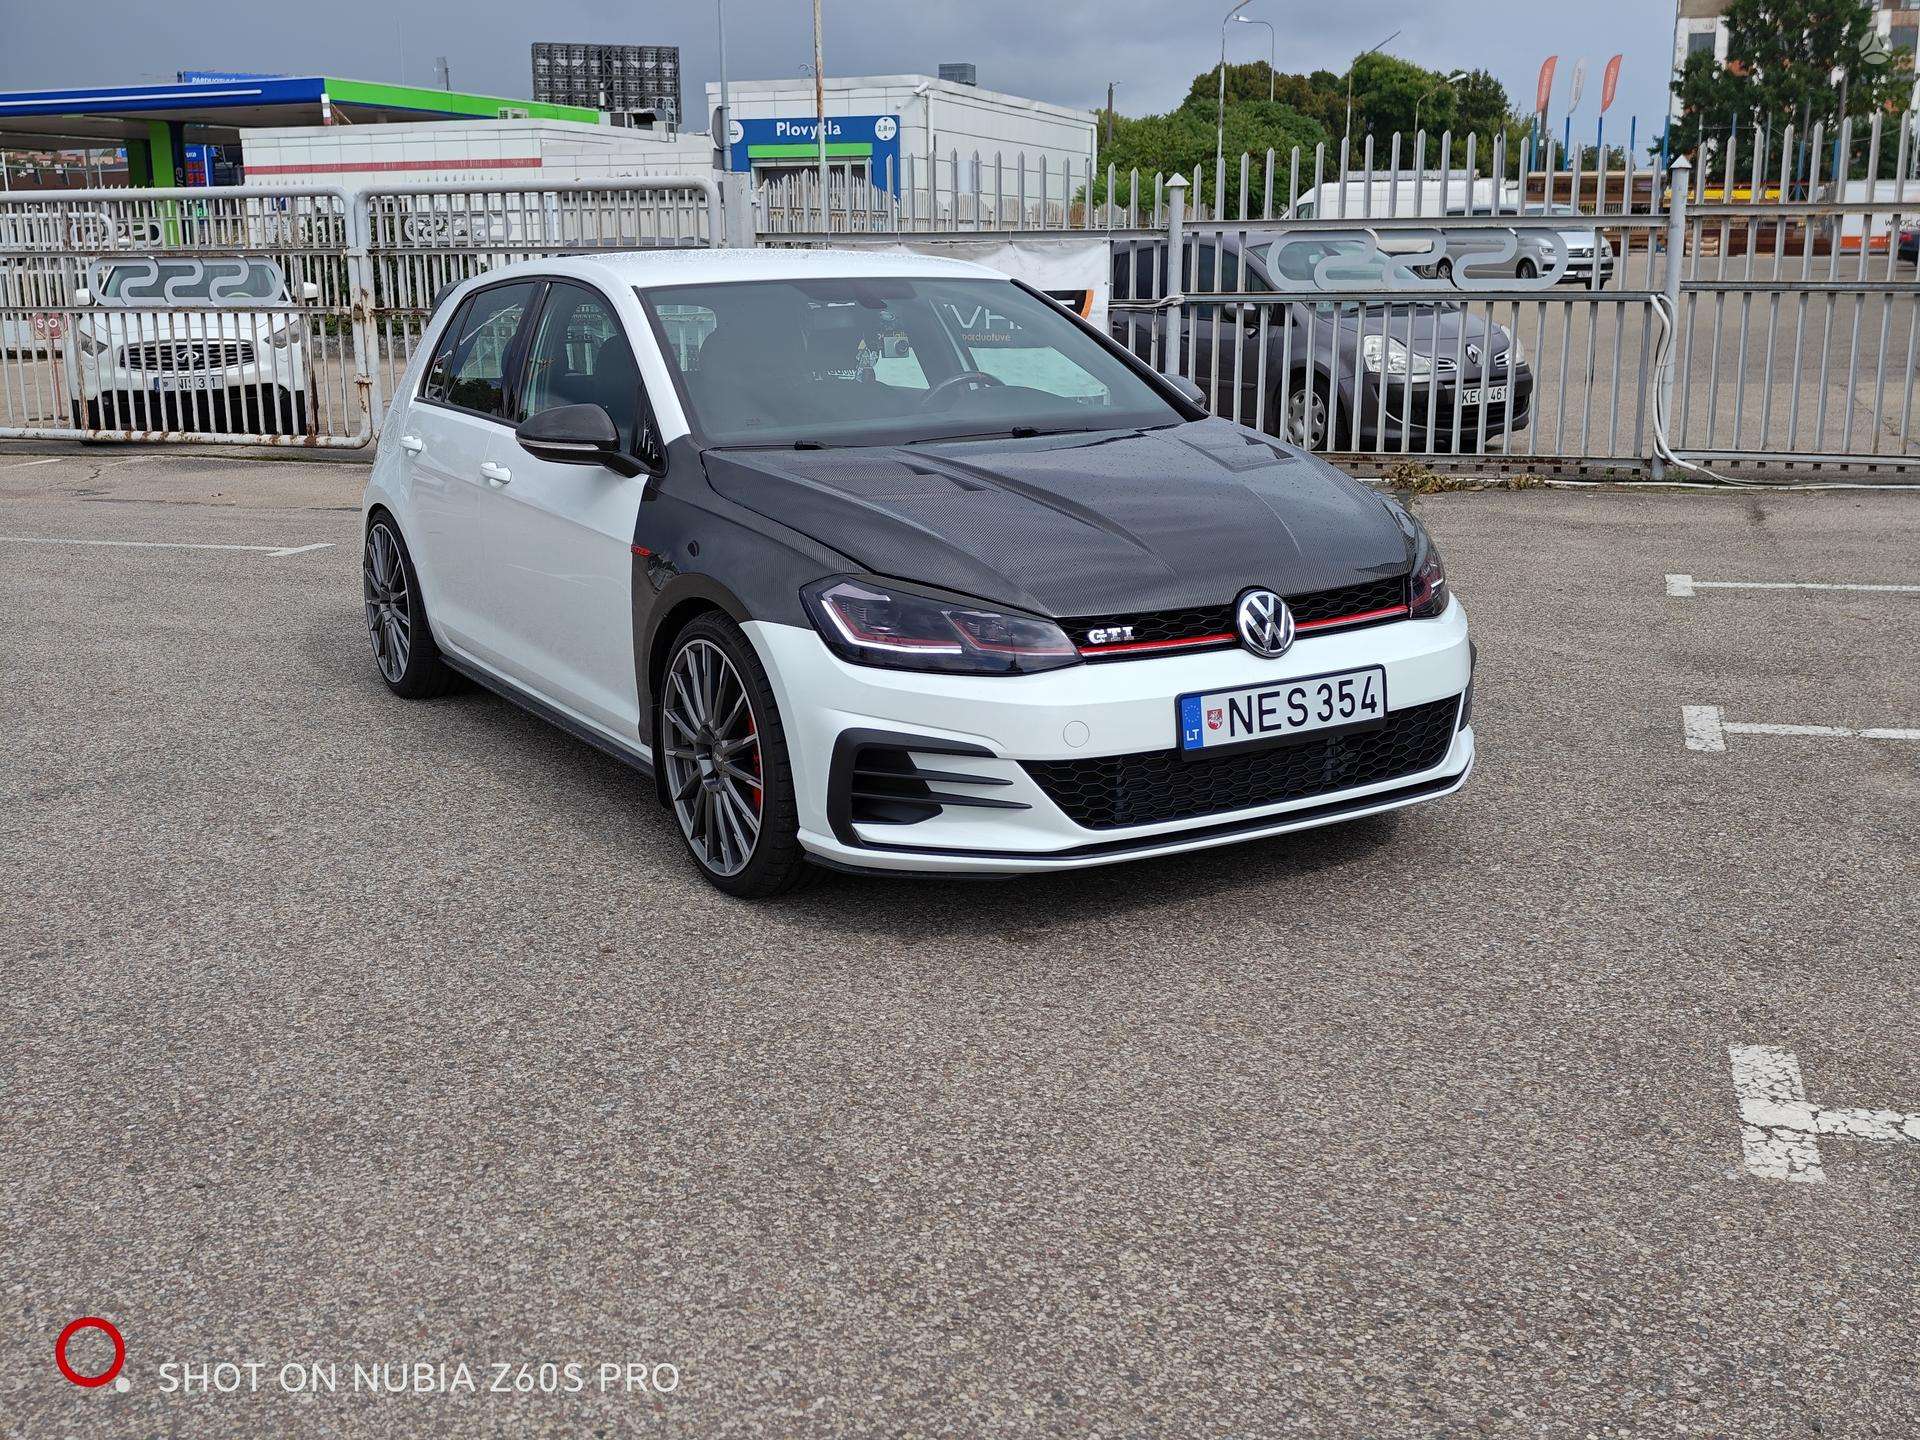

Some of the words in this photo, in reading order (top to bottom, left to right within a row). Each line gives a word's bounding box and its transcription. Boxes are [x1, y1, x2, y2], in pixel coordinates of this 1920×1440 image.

[198, 378, 216, 389] 31
[1462, 390, 1482, 404] KE
[1087, 626, 1135, 644] GTI
[1186, 728, 1200, 742] LT
[1228, 687, 1309, 738] NES
[1316, 675, 1378, 723] 354
